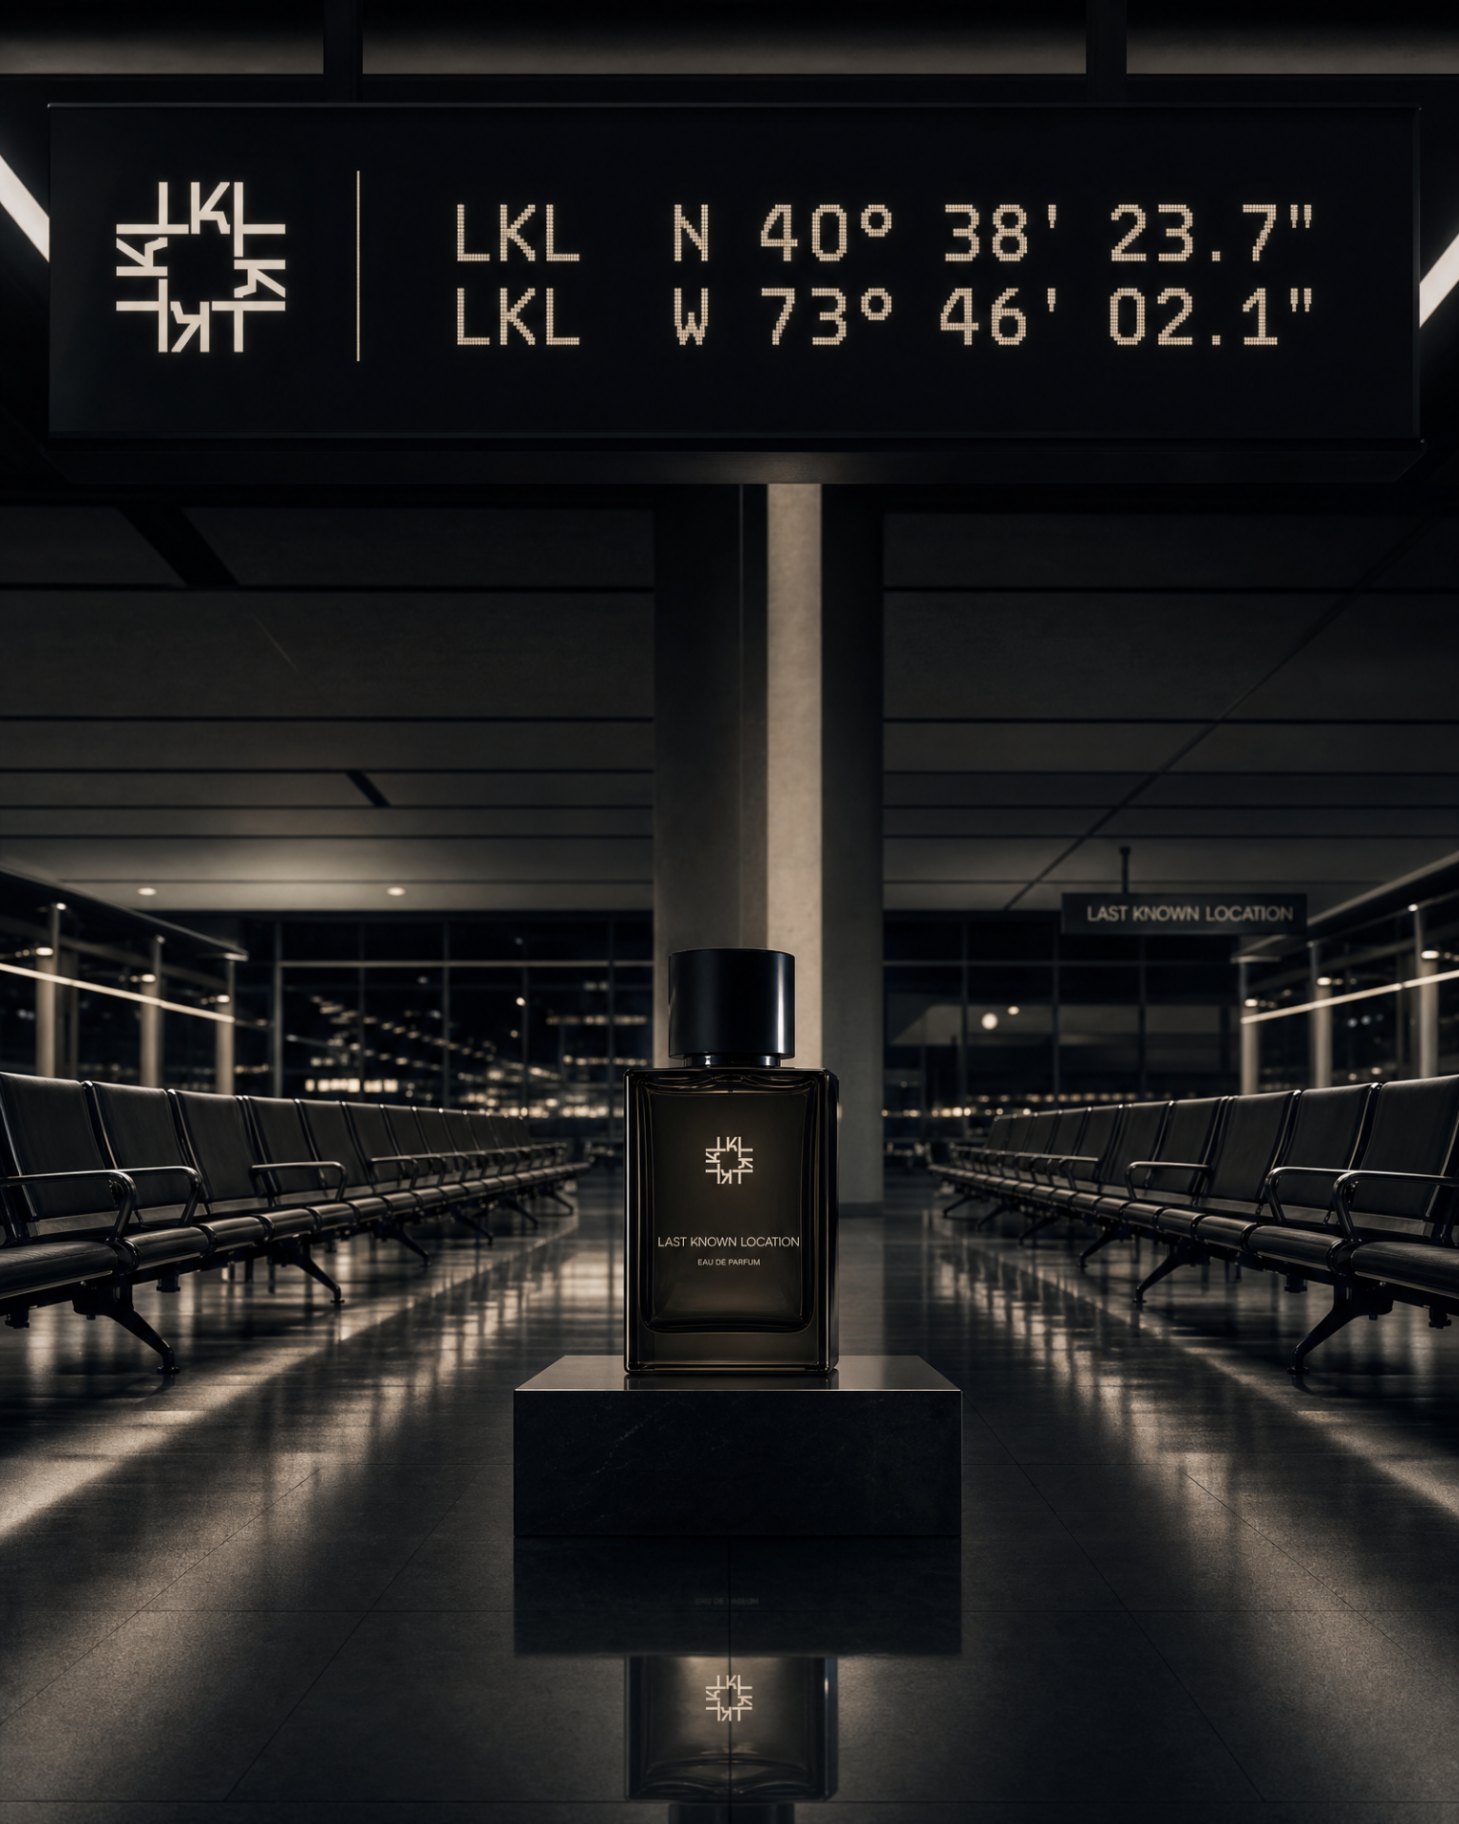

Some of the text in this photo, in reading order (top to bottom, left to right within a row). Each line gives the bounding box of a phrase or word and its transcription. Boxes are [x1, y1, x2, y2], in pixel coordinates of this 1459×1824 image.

[456, 203, 1312, 262] LKL N 40° 38' 23.7"
[456, 287, 580, 346] LKL
[673, 287, 709, 346] W
[761, 287, 893, 346] 73°
[940, 287, 1057, 346] 46'
[1087, 905, 1294, 922] LAST KNOWN LOCATION
[657, 1236, 800, 1247] LAST KNOWN LOCATION
[697, 1258, 761, 1266] EAU DE PARFUM
